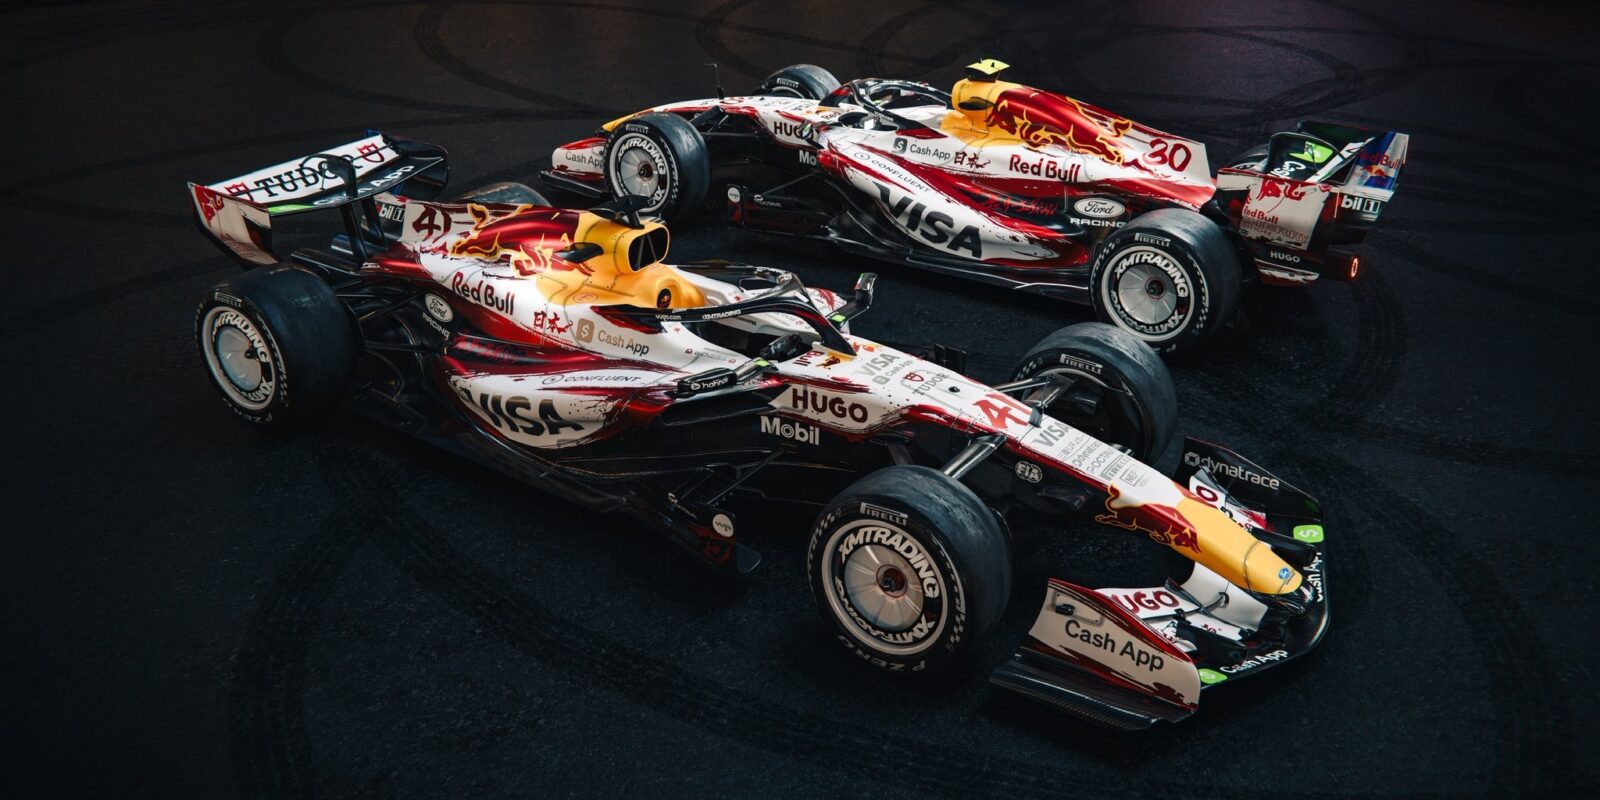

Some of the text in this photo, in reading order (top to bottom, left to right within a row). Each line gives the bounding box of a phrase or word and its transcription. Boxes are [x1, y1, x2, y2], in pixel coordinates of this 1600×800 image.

[565, 151, 587, 164] Cash
[909, 144, 951, 161] Cash App
[1142, 138, 1192, 172] 30
[871, 159, 932, 193] CONFLUENT
[1009, 154, 1081, 182] Red Bull
[872, 181, 983, 259] VISA
[1084, 200, 1115, 215] Ford
[1257, 211, 1279, 225] Bull
[1070, 217, 1127, 229] RACING
[1134, 232, 1172, 247] PIRELLI
[1270, 250, 1301, 263] HUGO
[1114, 251, 1189, 298] XMTRADING
[452, 272, 515, 316] Red Bull
[422, 312, 451, 340] RACING
[597, 330, 649, 356] Cash App
[853, 353, 901, 377] VISA
[1060, 353, 1104, 375] PIRELLI
[565, 375, 641, 383] CONFLUENT
[912, 372, 951, 396] TUDOR
[791, 387, 869, 424] HUGO
[760, 415, 820, 446] Mobil
[1032, 421, 1075, 448] VISA
[1018, 463, 1042, 482] FIA
[1201, 456, 1280, 490] dynatrace
[860, 502, 909, 527] PIRELLI
[838, 526, 940, 599] XMTRADING
[1111, 590, 1180, 614] UGO
[1064, 619, 1165, 672] Cash App
[1219, 649, 1289, 674] Cash App
